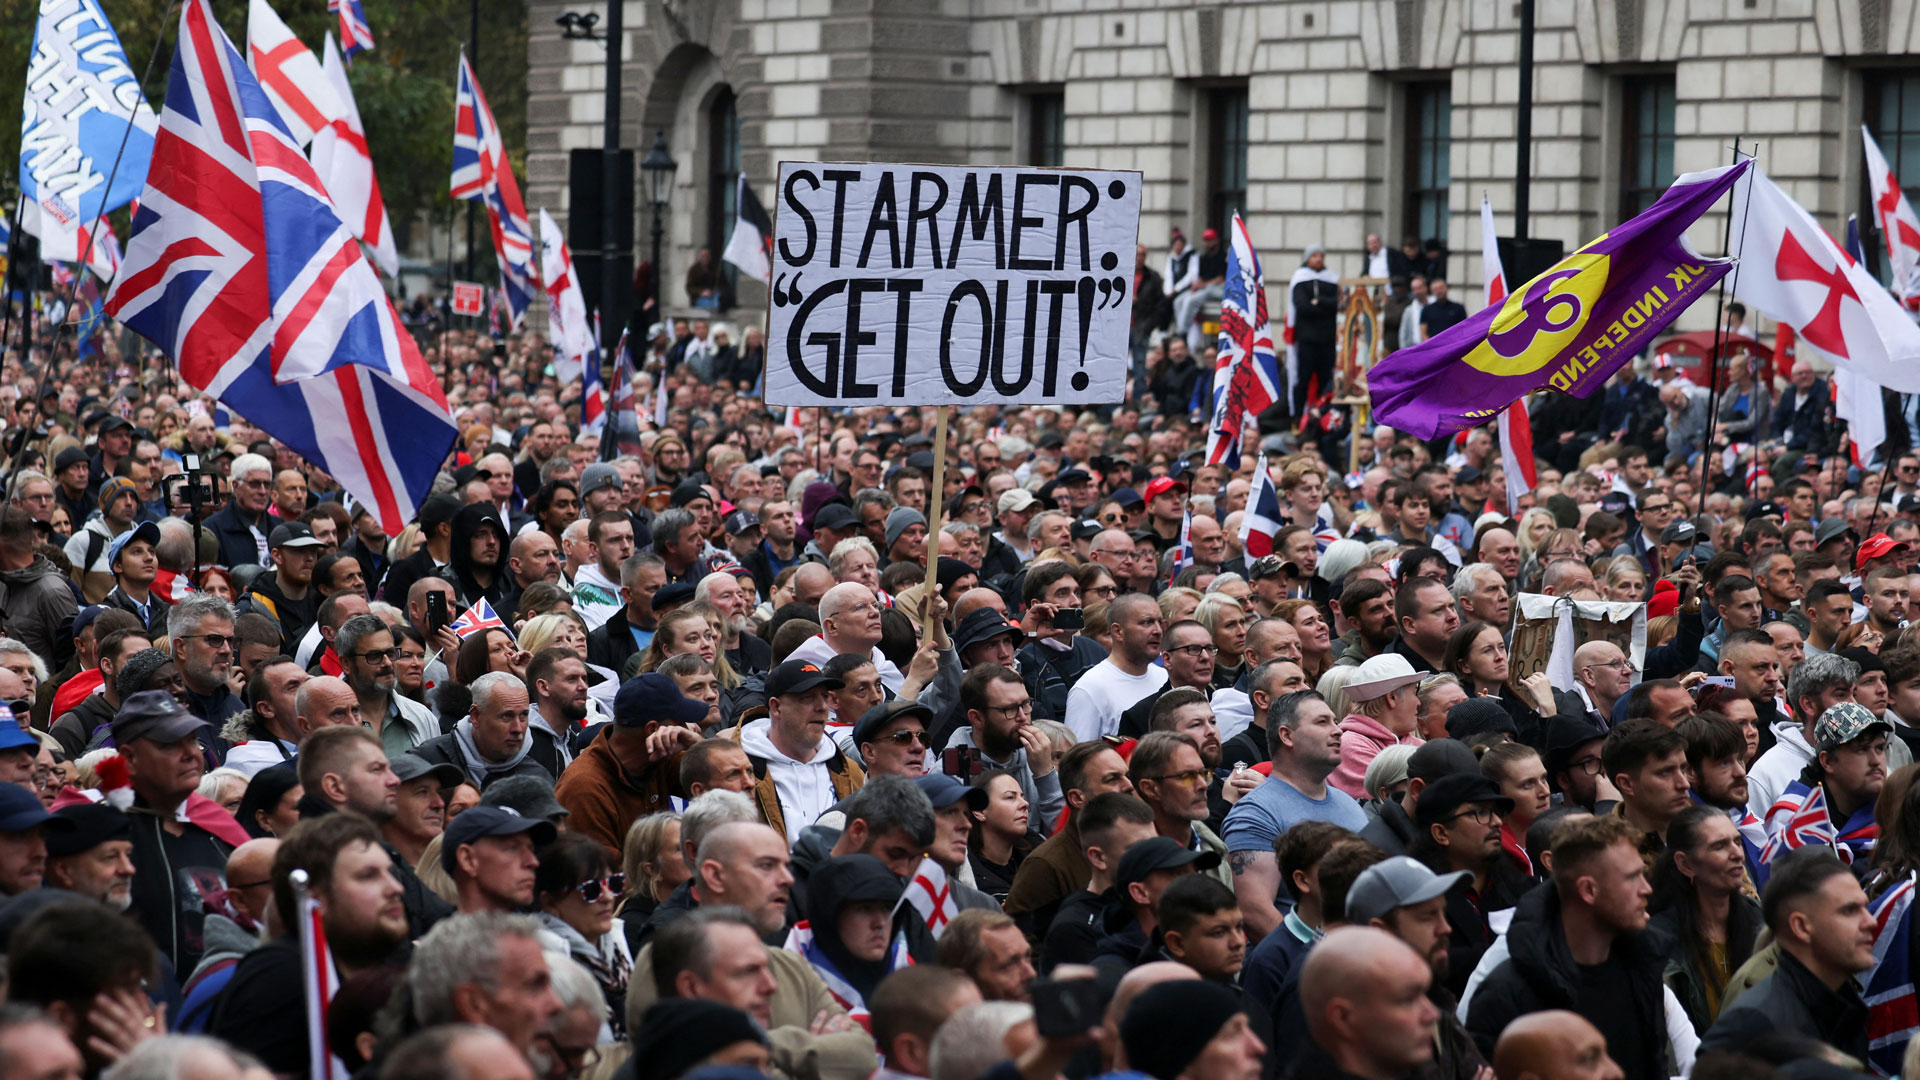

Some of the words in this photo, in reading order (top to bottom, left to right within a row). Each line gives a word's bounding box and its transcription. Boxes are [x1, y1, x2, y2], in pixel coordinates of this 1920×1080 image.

[778, 169, 1126, 271] STARMER:
[773, 271, 923, 398] “GET
[939, 276, 1126, 398] OUT!”
